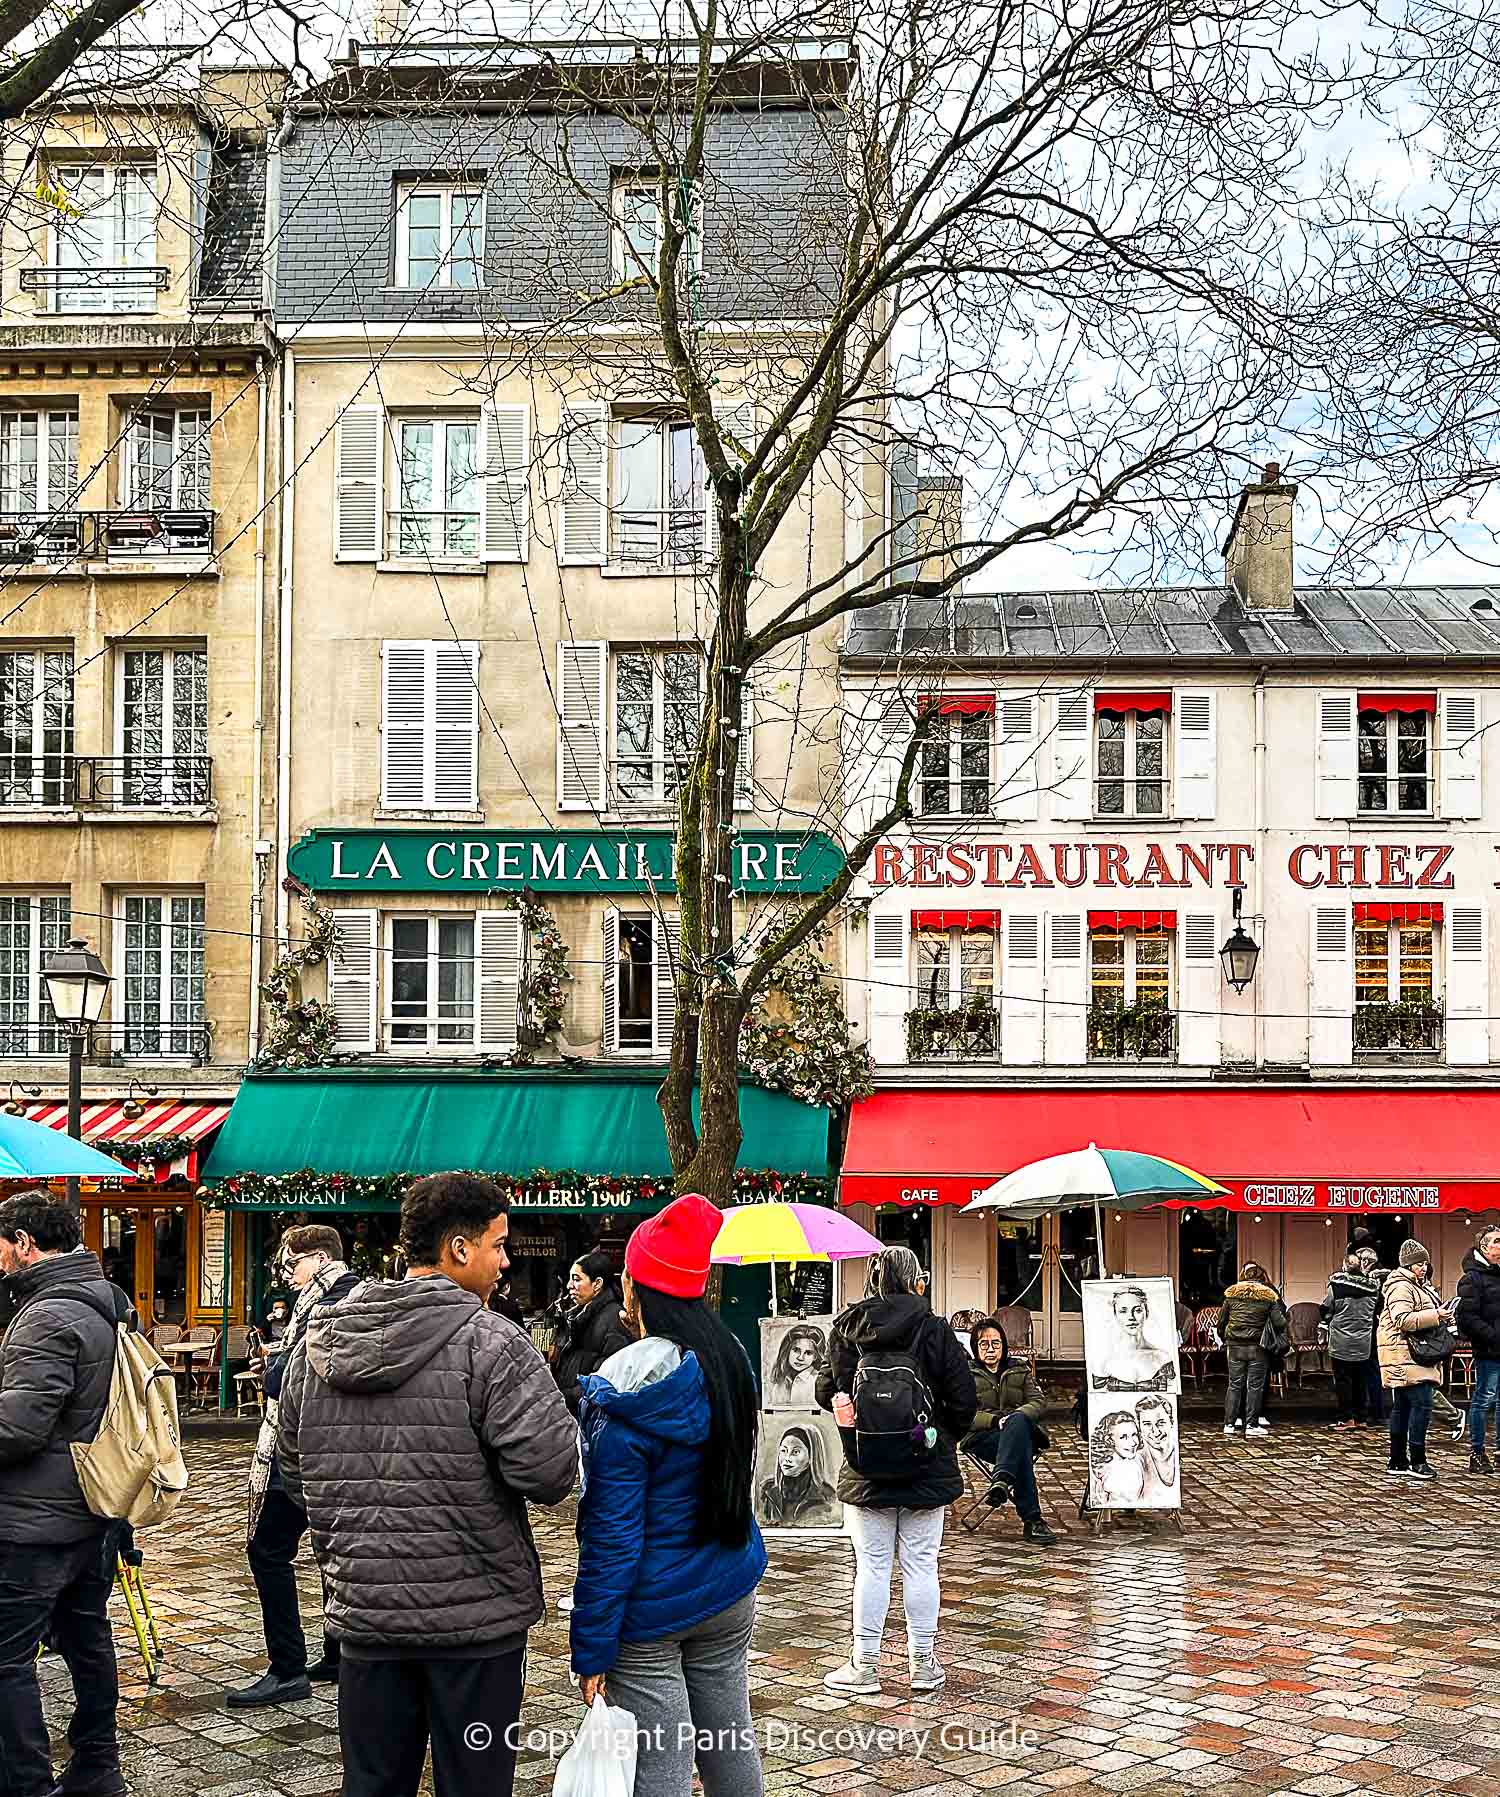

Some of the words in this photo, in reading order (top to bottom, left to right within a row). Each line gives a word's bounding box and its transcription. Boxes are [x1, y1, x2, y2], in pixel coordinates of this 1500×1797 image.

[331, 841, 402, 880] LA
[426, 842, 803, 881] CREMAILRE
[869, 844, 1256, 888] RESTAURANT
[1288, 844, 1455, 889] CHEZ
[732, 1189, 800, 1204] ABARET
[901, 1189, 939, 1201] CAFE
[1244, 1184, 1315, 1206] CHEZ
[1327, 1185, 1439, 1208] EUGENE
